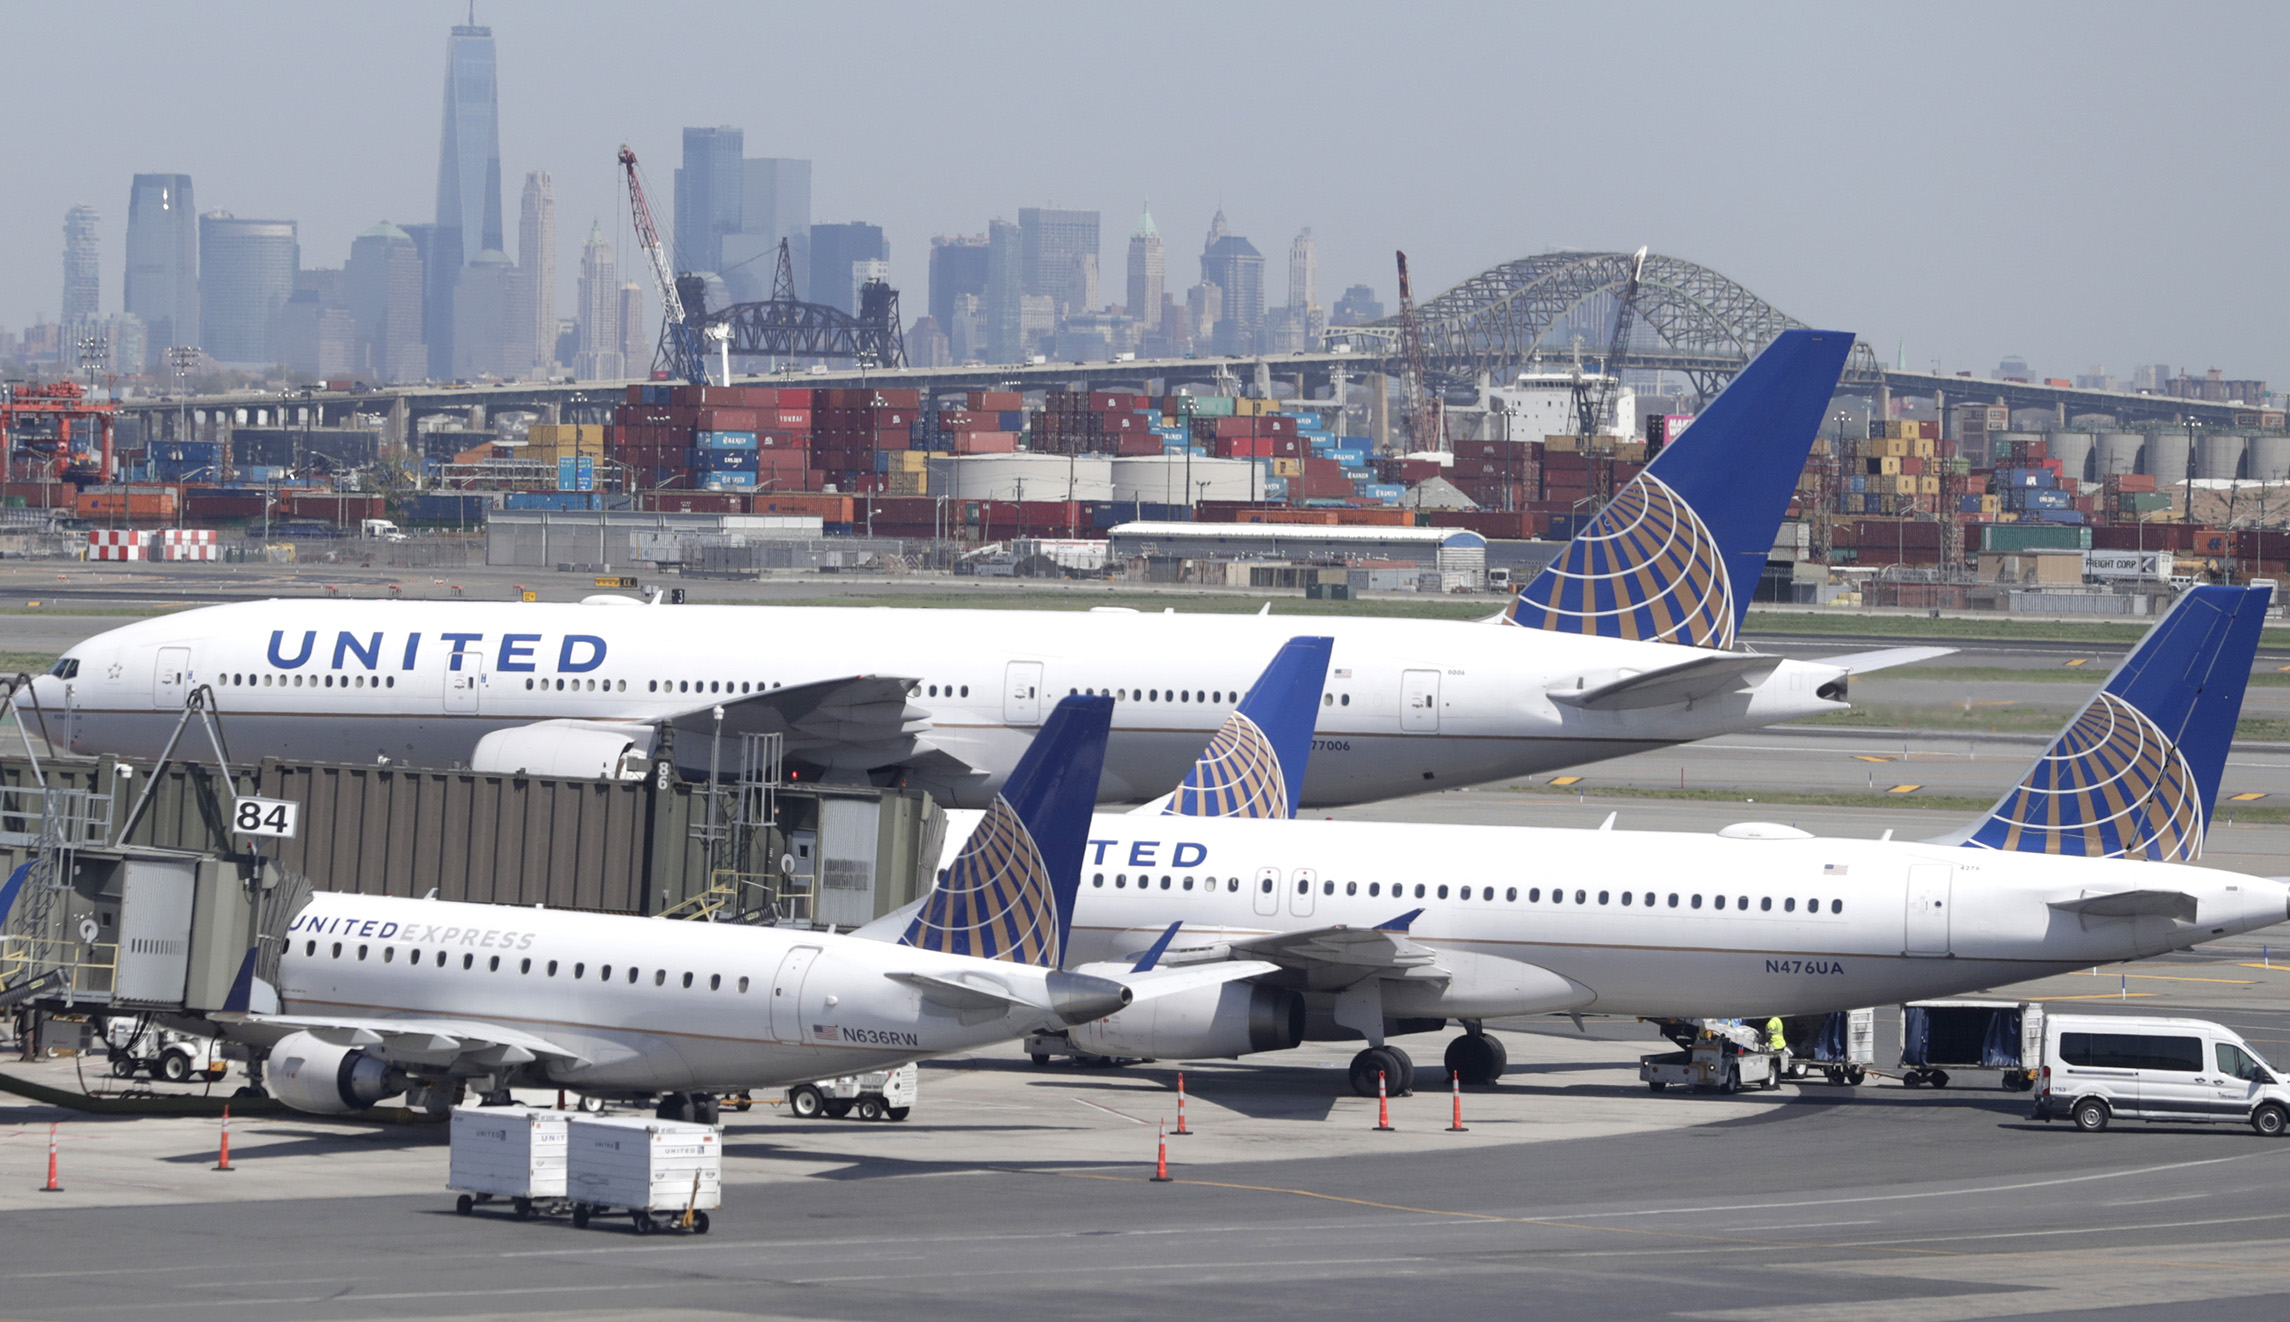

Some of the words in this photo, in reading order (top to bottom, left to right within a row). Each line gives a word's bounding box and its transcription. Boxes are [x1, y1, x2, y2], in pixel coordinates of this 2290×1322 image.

[2086, 559, 2114, 568] FREIGHT
[677, 589, 683, 604] 3
[266, 630, 608, 673] UNITED
[1311, 740, 1351, 751] 77006
[657, 761, 669, 790] 86
[236, 801, 288, 833] 84
[1087, 839, 1208, 868] TED
[1765, 959, 1844, 975] N476UA
[842, 1026, 919, 1047] N636RW
[541, 1134, 567, 1142] UNIT
[664, 1147, 696, 1155] UNITED
